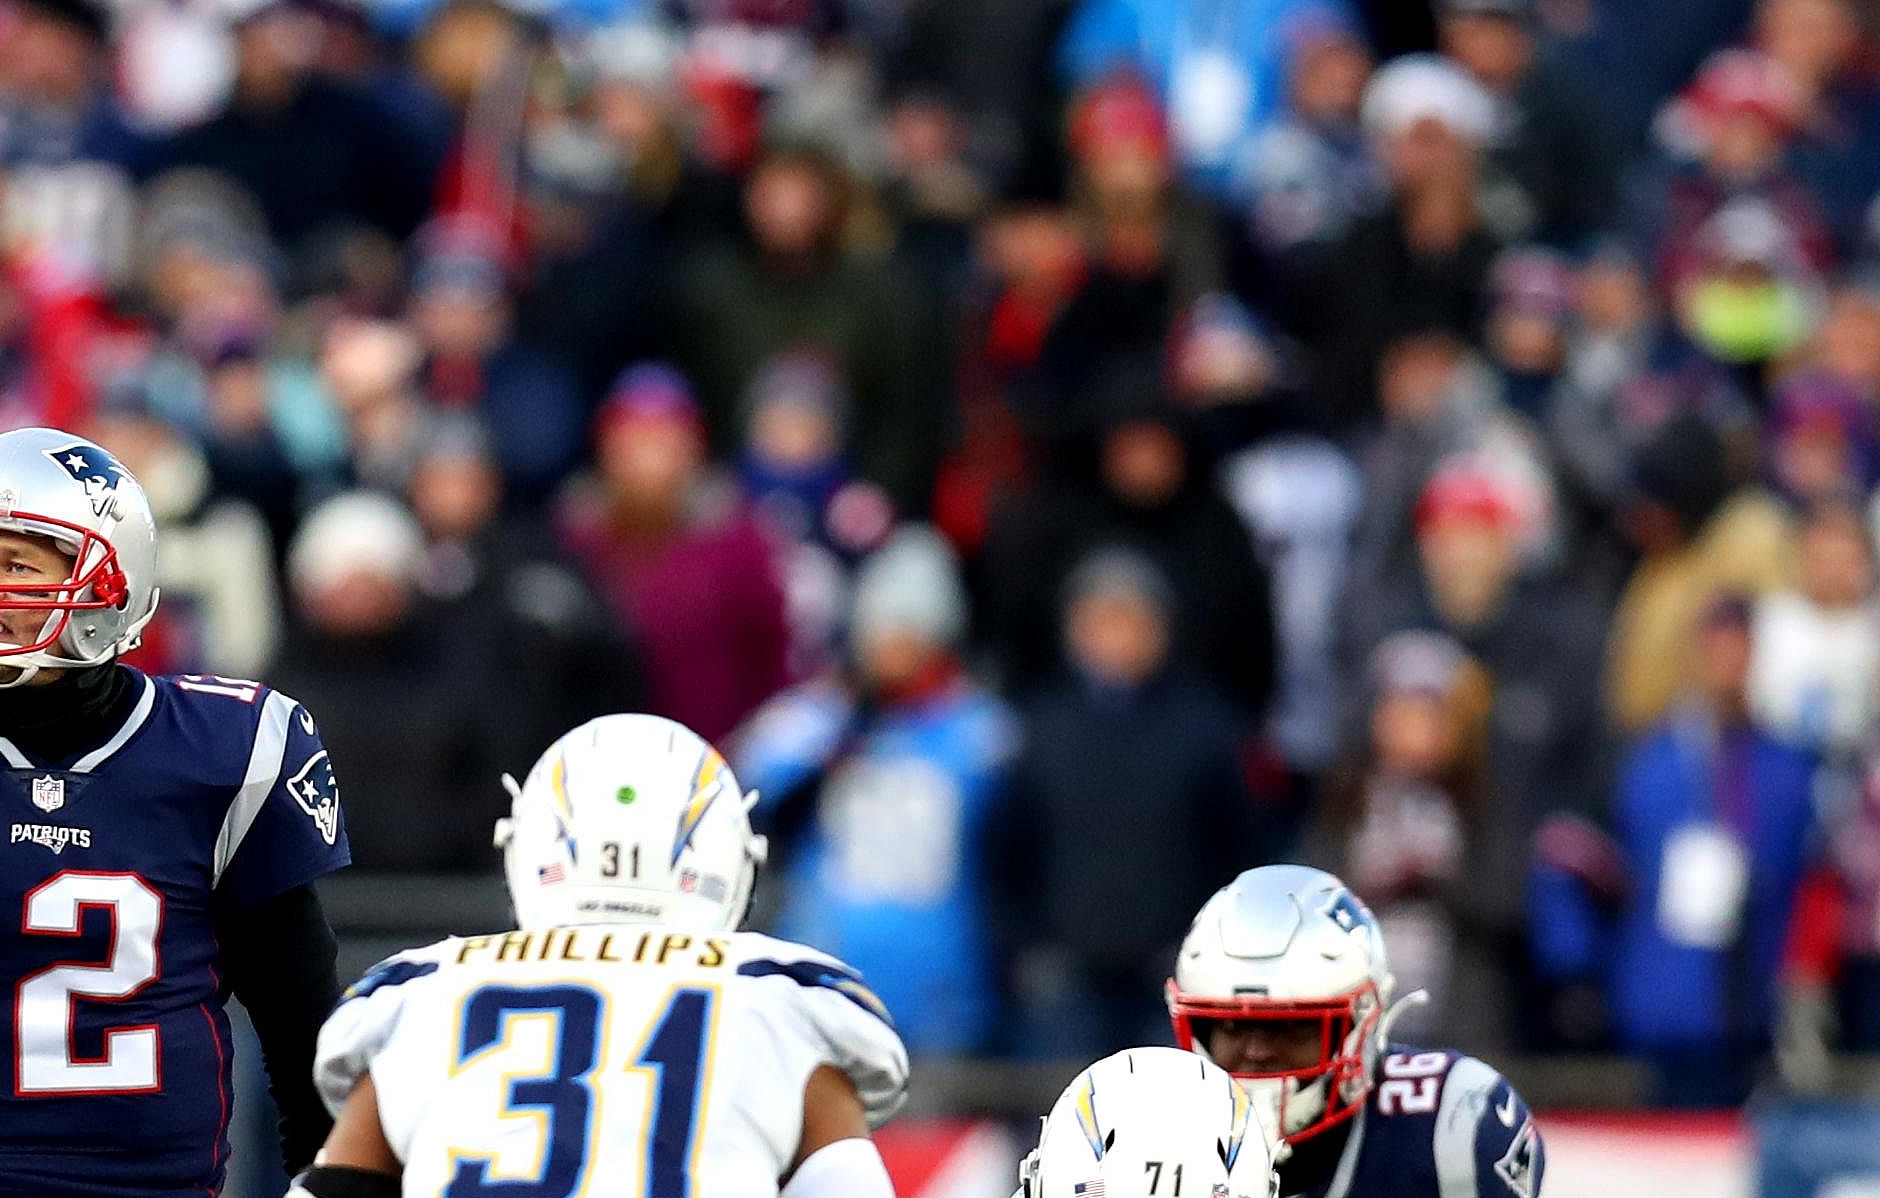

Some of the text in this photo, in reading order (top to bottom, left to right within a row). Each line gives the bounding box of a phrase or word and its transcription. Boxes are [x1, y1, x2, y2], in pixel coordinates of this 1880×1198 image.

[10, 823, 92, 849] PATRIOTS
[602, 841, 641, 879] 31
[454, 927, 732, 968] PHILLIPS
[1378, 1050, 1453, 1115] 26
[1144, 1160, 1183, 1198] 71
